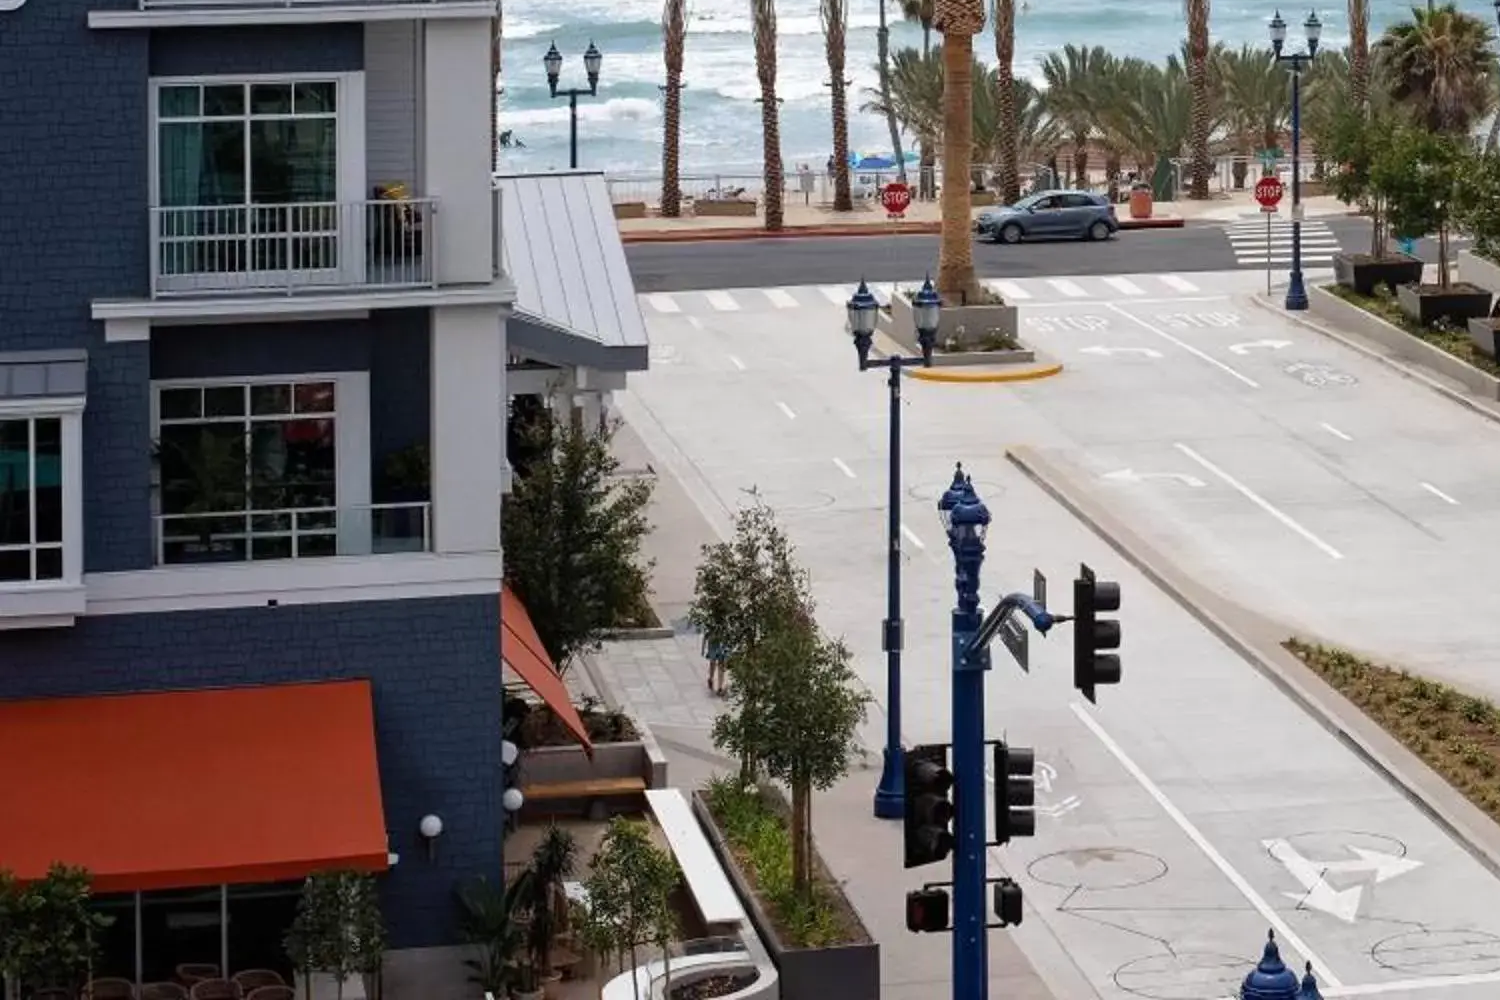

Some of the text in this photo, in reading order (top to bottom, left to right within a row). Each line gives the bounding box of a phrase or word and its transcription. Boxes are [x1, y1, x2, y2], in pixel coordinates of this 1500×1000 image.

[883, 191, 909, 204] STOP
[1257, 185, 1281, 199] STOP
[1024, 314, 1109, 333] STOP
